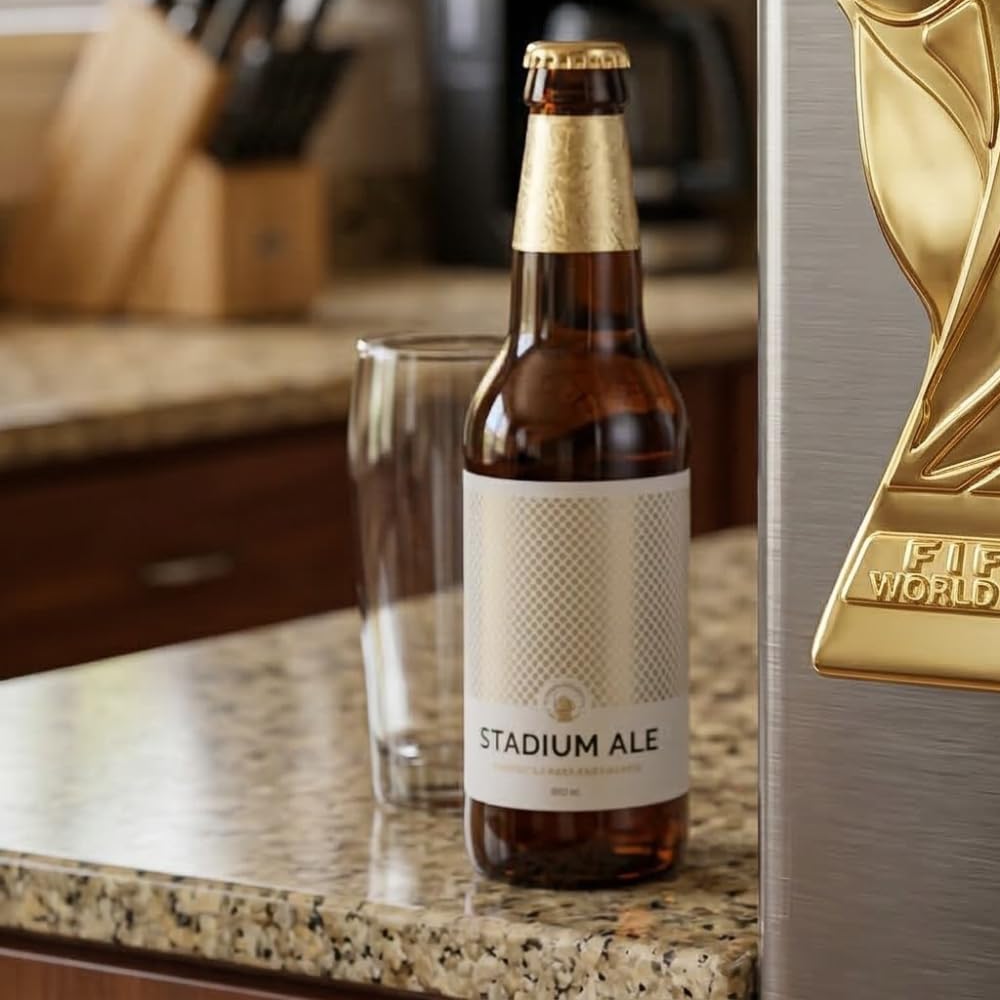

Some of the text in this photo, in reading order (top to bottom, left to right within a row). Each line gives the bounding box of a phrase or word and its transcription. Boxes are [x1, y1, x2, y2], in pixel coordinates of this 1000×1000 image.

[869, 570, 1000, 608] WORLD
[480, 727, 659, 757] STADIUM ALE
